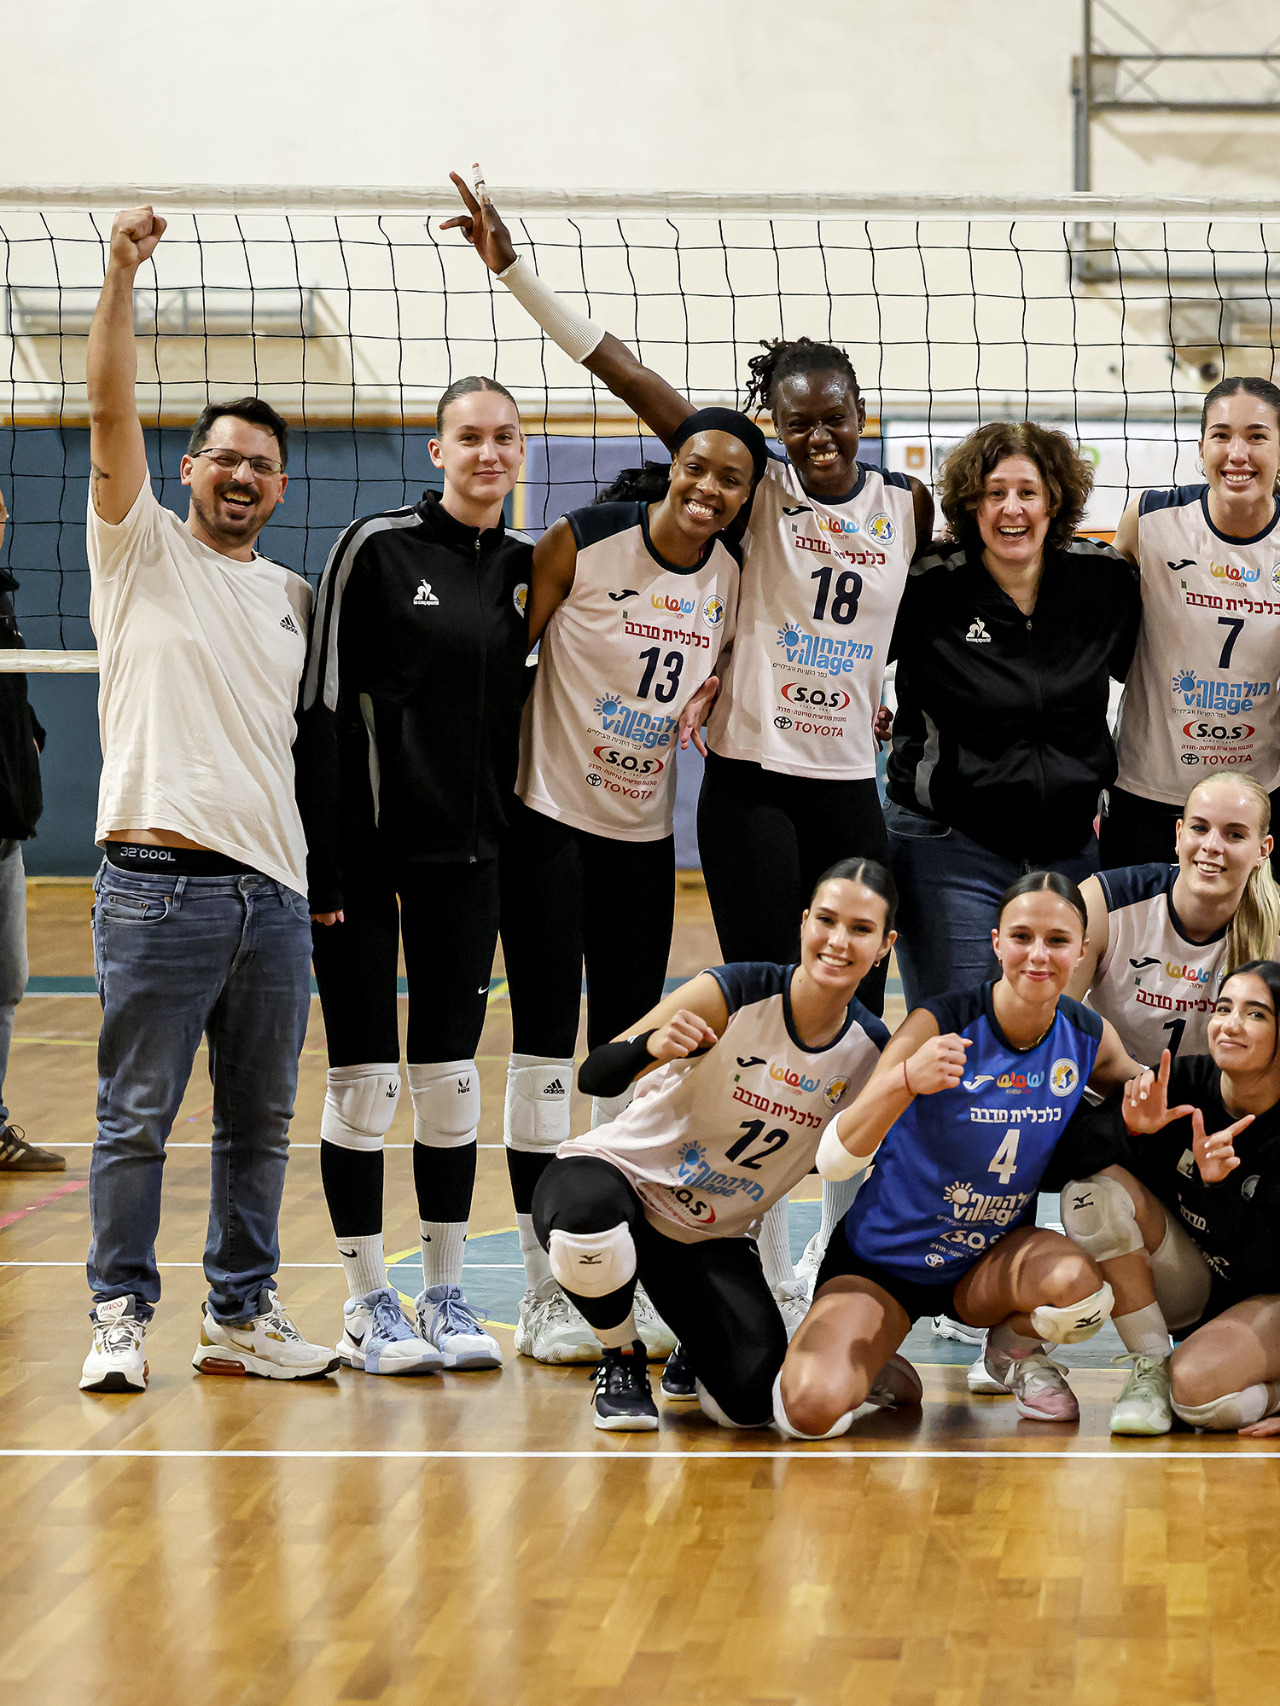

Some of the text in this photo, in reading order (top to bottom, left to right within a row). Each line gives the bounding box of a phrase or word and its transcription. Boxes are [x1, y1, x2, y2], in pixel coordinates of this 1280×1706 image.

[811, 566, 862, 625] 18
[1186, 592, 1223, 609] חדרה
[625, 621, 660, 640] חדרה
[1217, 616, 1244, 669] 7
[786, 640, 854, 676] village
[637, 647, 684, 703] 13
[794, 687, 840, 708] S.O.S
[1183, 686, 1253, 716] village
[602, 711, 671, 749] village
[794, 720, 844, 738] TOYOTA
[1196, 723, 1242, 740] S.O.S
[605, 751, 654, 773] S.O.S
[1201, 753, 1253, 765] TOYOTA
[603, 778, 653, 800] TOYOTA
[1136, 988, 1172, 1010] חדרה
[732, 1086, 823, 1129] כלכלית חדרה
[970, 1106, 1062, 1124] כלכלית חדרה
[724, 1119, 790, 1170] 12
[987, 1129, 1020, 1185] 4
[953, 1199, 1020, 1227] village
